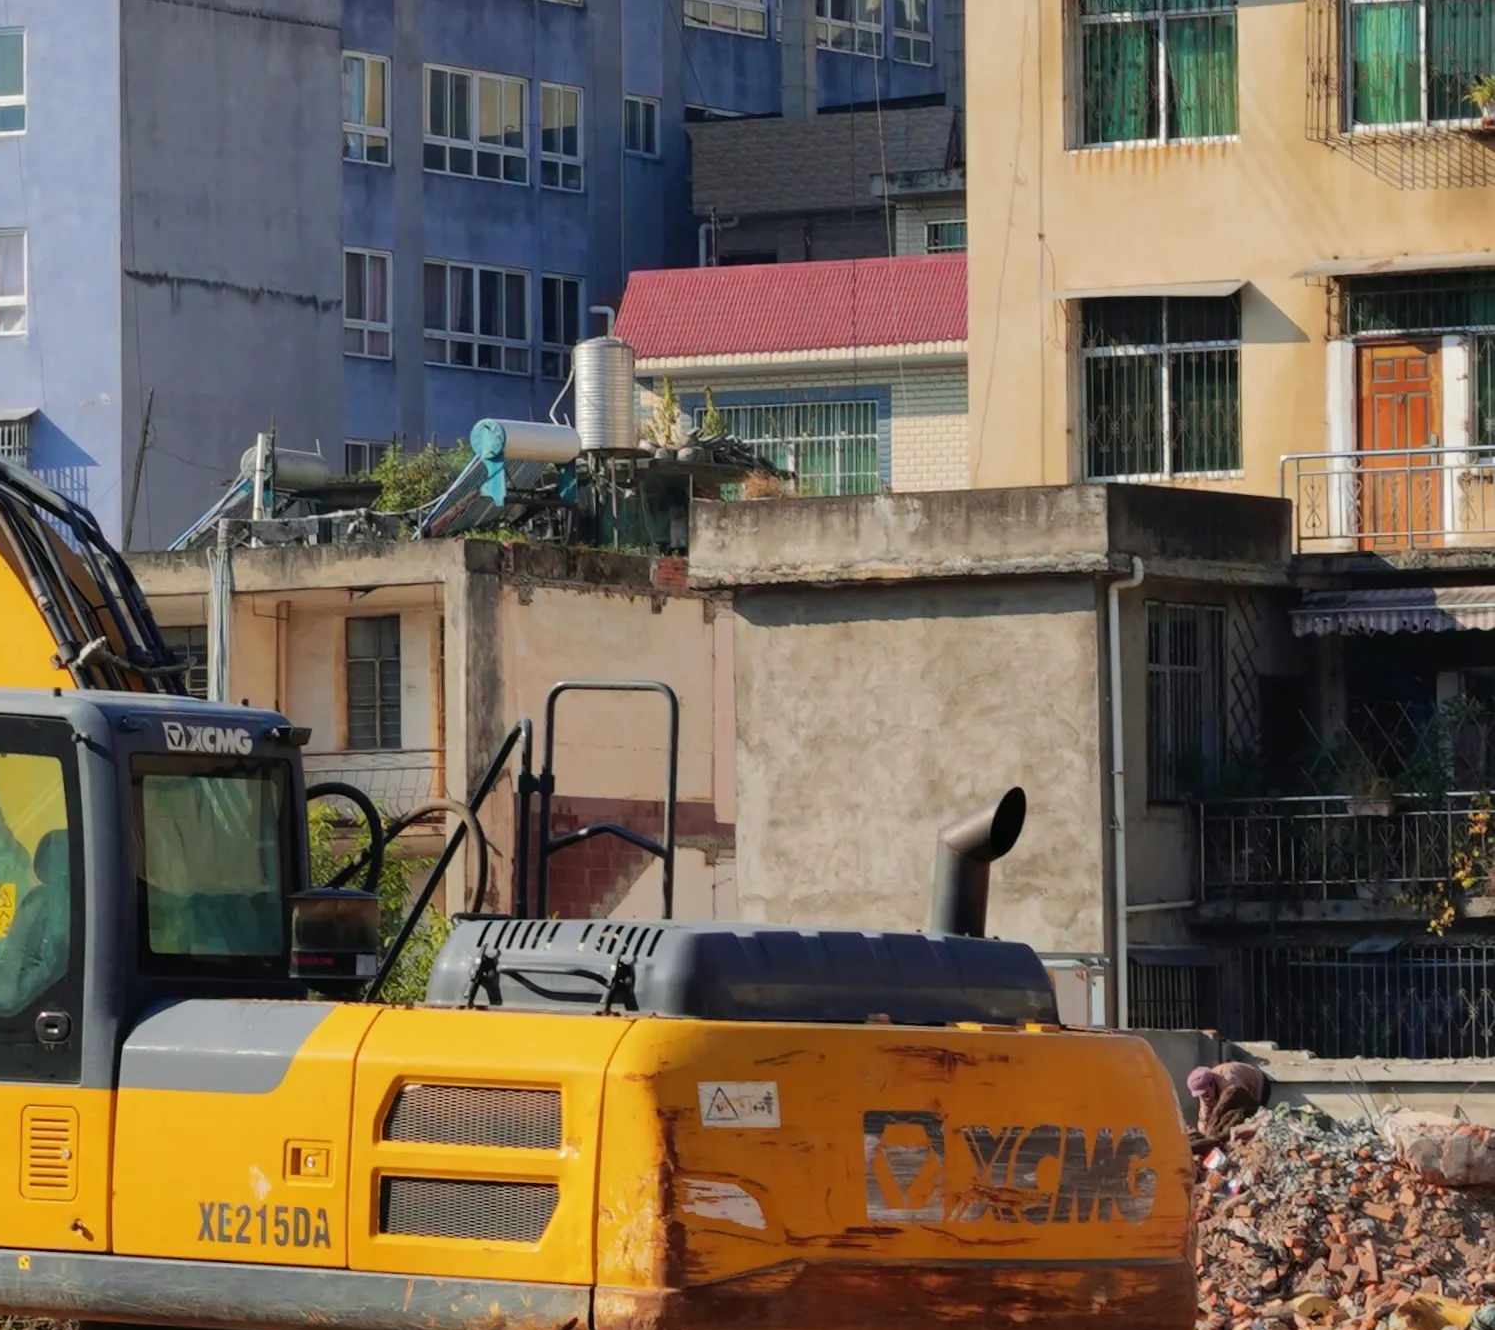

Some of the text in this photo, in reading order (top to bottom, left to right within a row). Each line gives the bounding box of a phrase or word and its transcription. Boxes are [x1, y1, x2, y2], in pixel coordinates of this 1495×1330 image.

[184, 725, 253, 755] XCMG
[947, 1124, 1158, 1227] XCMG
[197, 1201, 332, 1249] XE215DA
